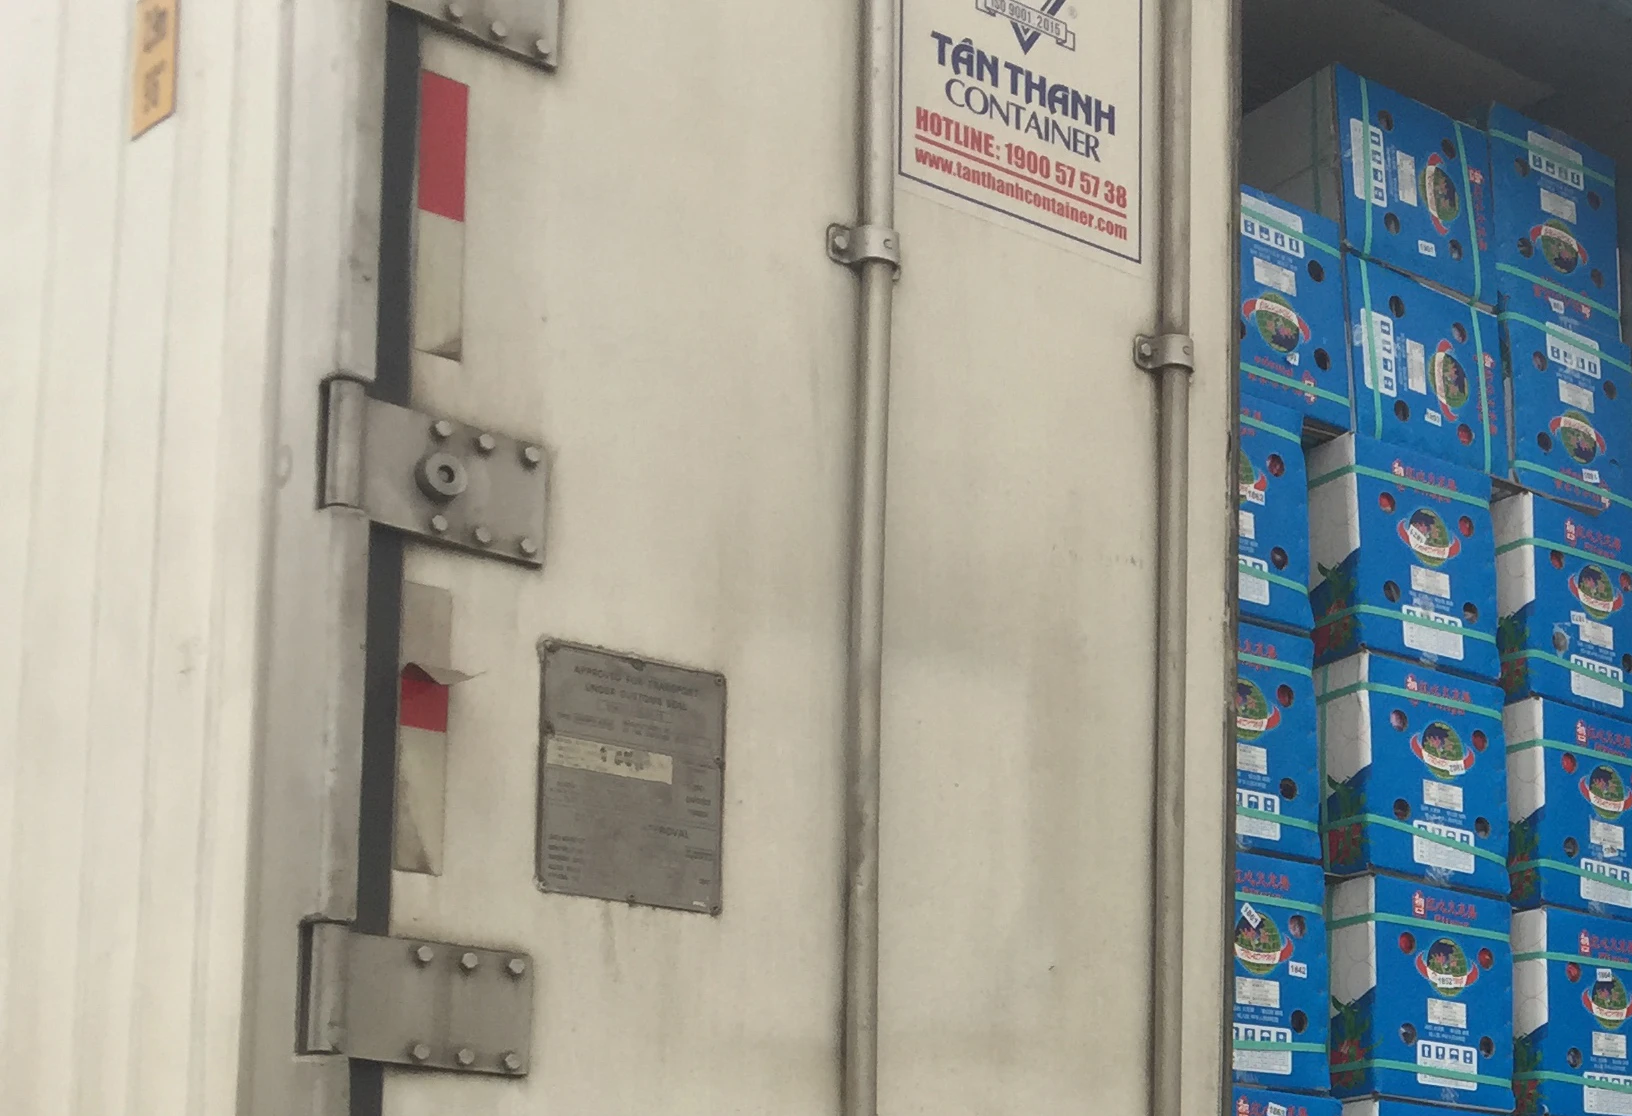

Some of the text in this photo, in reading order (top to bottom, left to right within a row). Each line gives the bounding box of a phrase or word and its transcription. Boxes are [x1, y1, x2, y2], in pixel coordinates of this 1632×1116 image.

[930, 30, 1116, 136] TÂN THANH
[945, 78, 1101, 163] CONTAINER
[915, 147, 1128, 241] www.tanthanhcontainer.com
[916, 106, 1127, 208] HOTLINE: 1900 57 57 38
